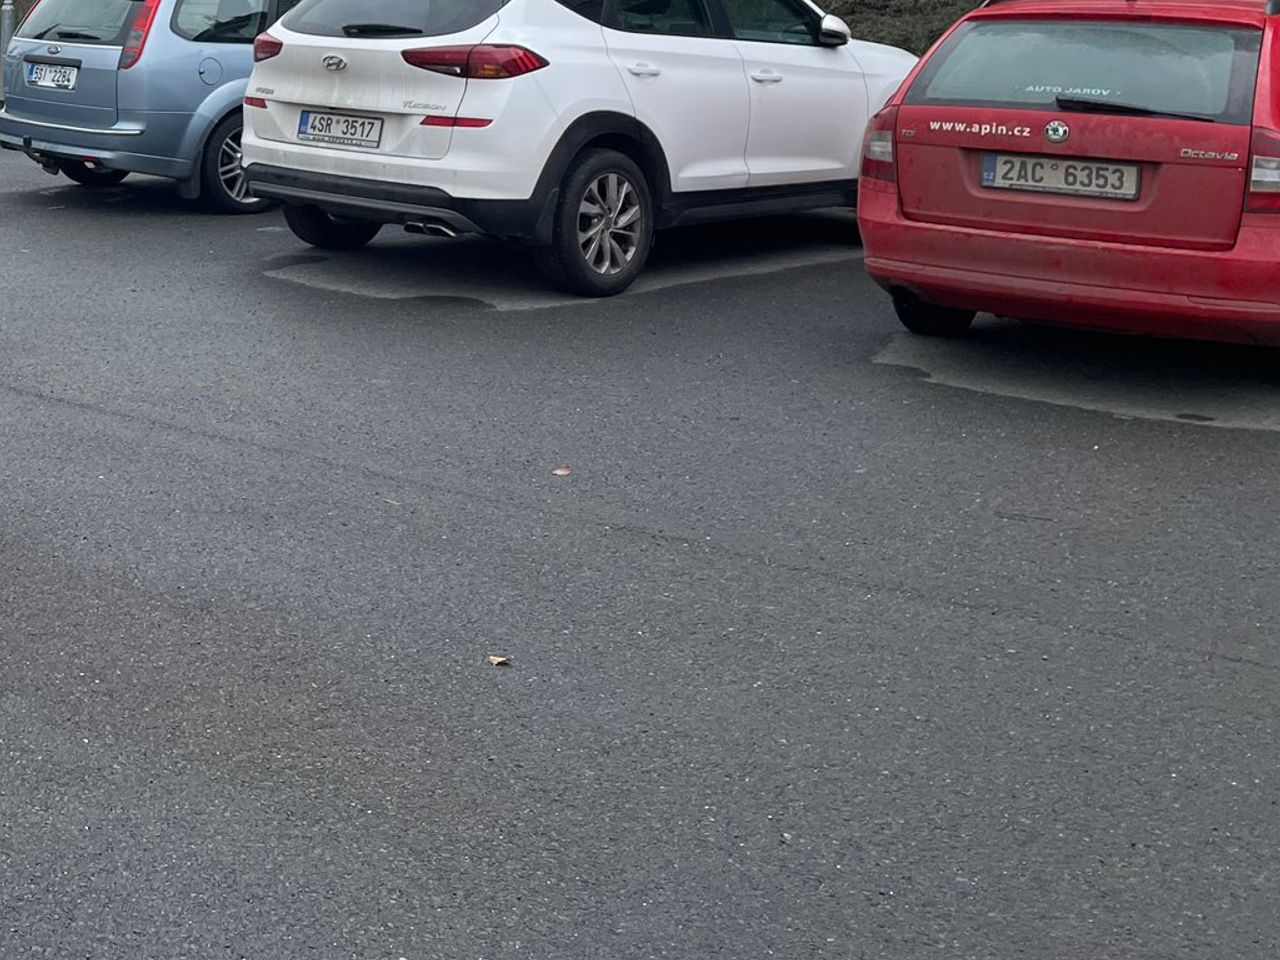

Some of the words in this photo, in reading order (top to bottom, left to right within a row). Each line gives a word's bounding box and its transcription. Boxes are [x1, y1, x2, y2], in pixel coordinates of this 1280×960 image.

[1025, 85, 1062, 93] AUTO
[1064, 87, 1111, 97] JAROV
[310, 116, 332, 134] 4SR
[341, 121, 375, 138] 3517
[929, 120, 1031, 137] www.apin.cz
[1180, 147, 1239, 161] Octavia
[1001, 159, 1045, 183] 2AC
[1064, 164, 1125, 191] 6353
